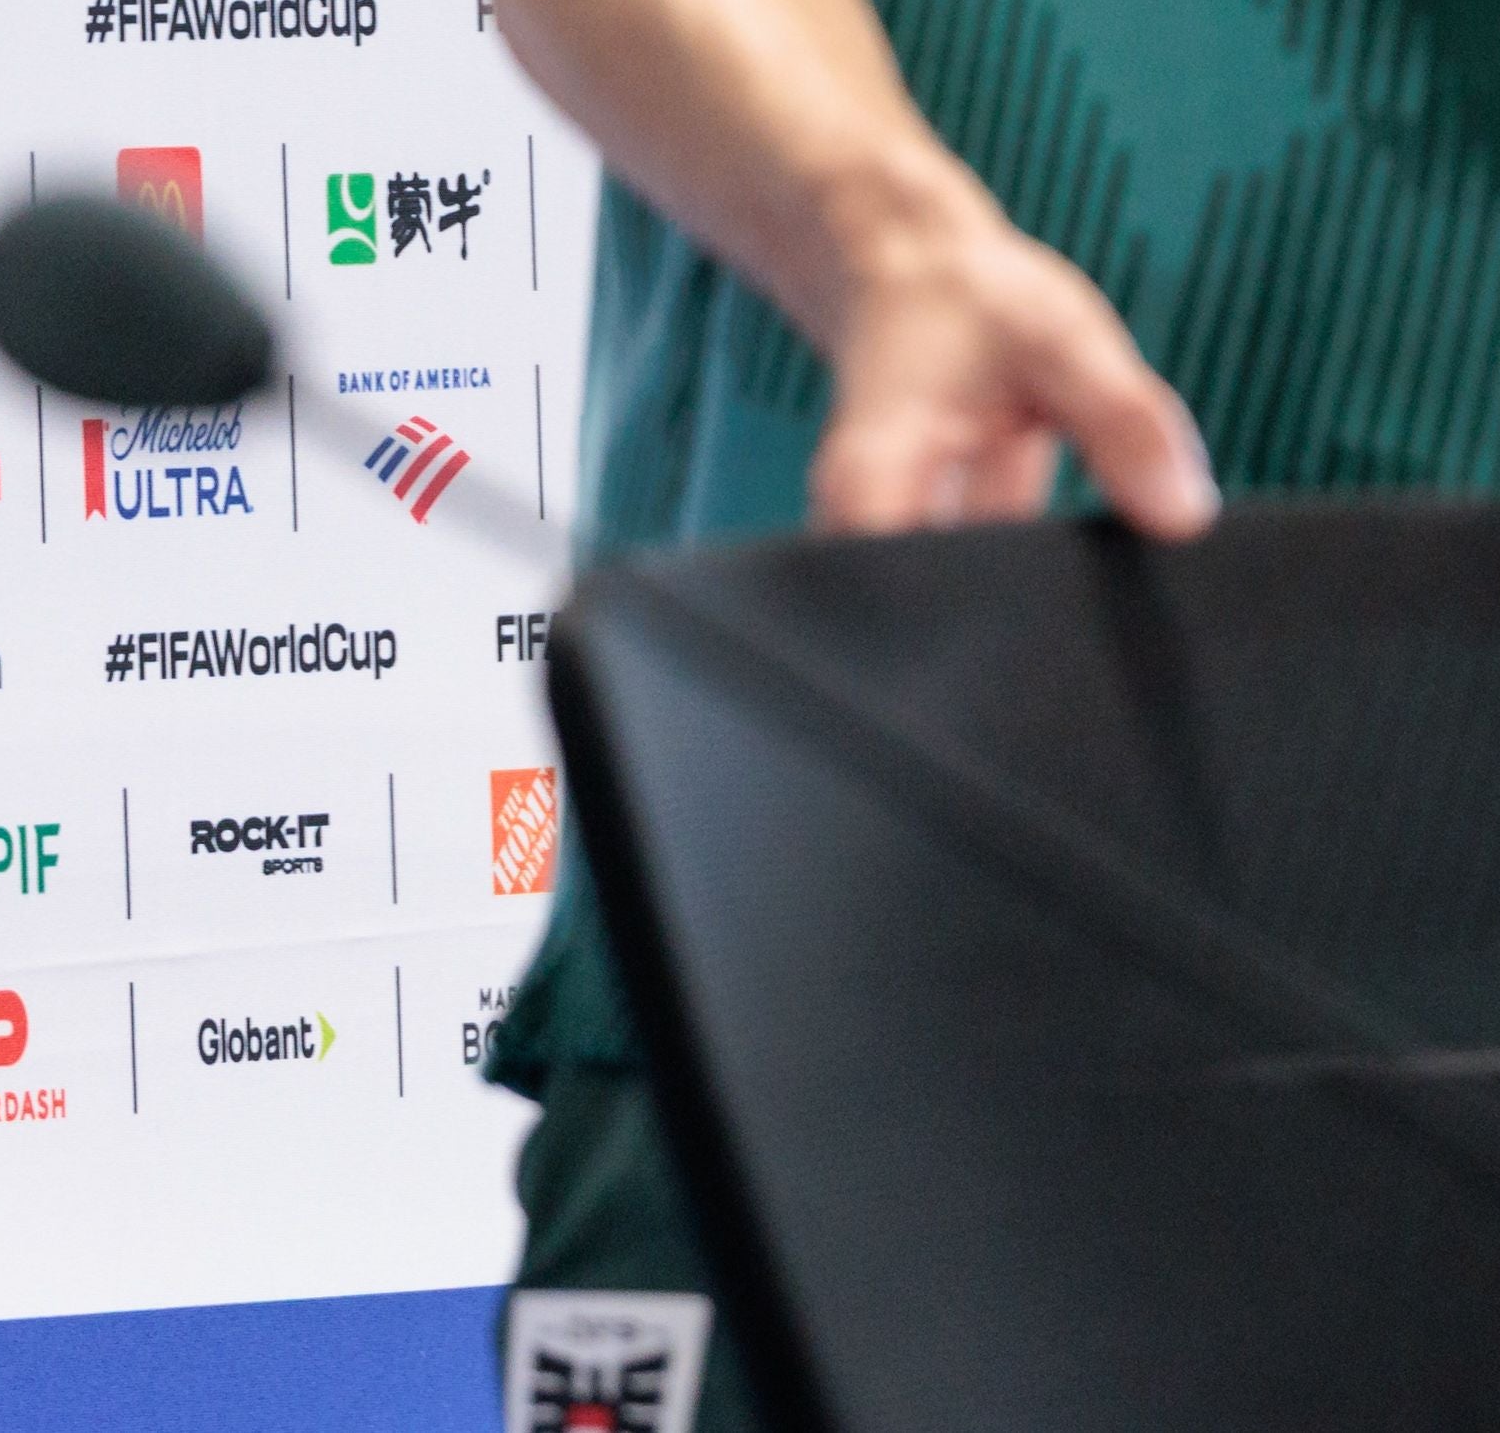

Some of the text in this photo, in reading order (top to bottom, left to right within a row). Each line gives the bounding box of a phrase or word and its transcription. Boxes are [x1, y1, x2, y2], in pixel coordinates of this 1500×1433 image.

[339, 368, 490, 394] BANK OF AMERICA
[114, 466, 253, 520] ULTRA
[105, 623, 396, 682] #FIFAWorldCup
[191, 814, 329, 855] ROCK-IT
[263, 857, 323, 876] SPORTS
[198, 1017, 314, 1065] Globant
